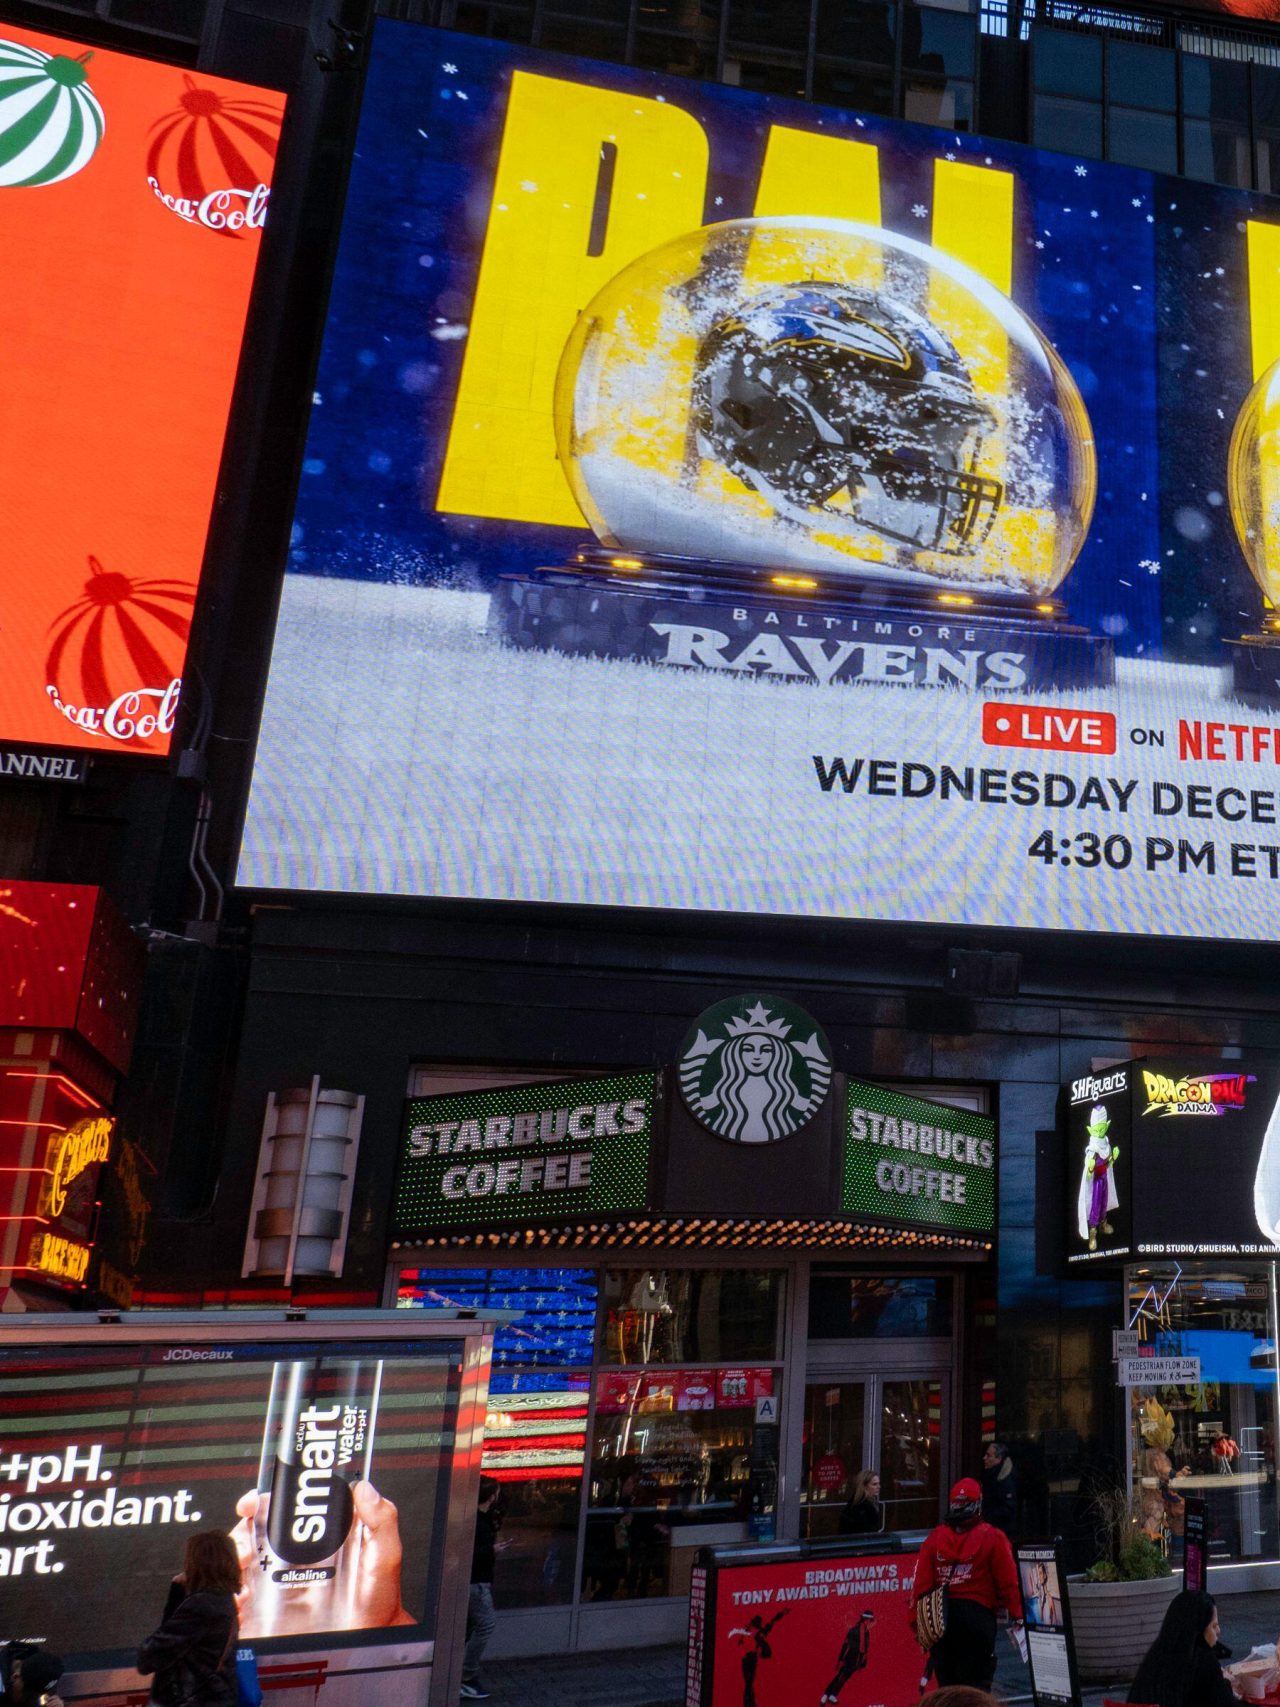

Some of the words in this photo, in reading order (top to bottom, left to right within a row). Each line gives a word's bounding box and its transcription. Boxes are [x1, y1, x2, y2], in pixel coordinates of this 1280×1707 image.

[732, 608, 976, 642] BALTIMORE
[650, 622, 1027, 689] RAVENS
[1021, 712, 1103, 746] LIVE
[1130, 727, 1164, 748] ON
[812, 755, 1138, 813] WEDNESDAY
[1028, 830, 1133, 870] 4:30
[1145, 836, 1215, 874] PM
[1142, 1070, 1211, 1103] DRAGON
[1177, 1102, 1217, 1114] DAIMA
[409, 1100, 647, 1158] STARBUCKS
[851, 1107, 994, 1168] STARBUCKS
[441, 1152, 594, 1200] COFFEE
[875, 1159, 967, 1204] COFFEE
[1240, 1245, 1257, 1253] TOEI
[162, 1349, 234, 1361] JCDecaux
[1128, 1361, 1164, 1370] PEDESTRIAN
[1165, 1361, 1181, 1370] FLOW
[1182, 1360, 1197, 1369] ZONE
[1128, 1372, 1144, 1382] KEEP
[1144, 1371, 1167, 1381] MOVING
[760, 1400, 773, 1415] A
[0, 1445, 112, 1492] +pH.
[291, 1405, 341, 1543] smart
[0, 1487, 202, 1533] ioxidant.
[281, 1570, 327, 1582] alkaline
[805, 1564, 898, 1585] BROADWAY'S
[732, 1588, 775, 1605] TONY
